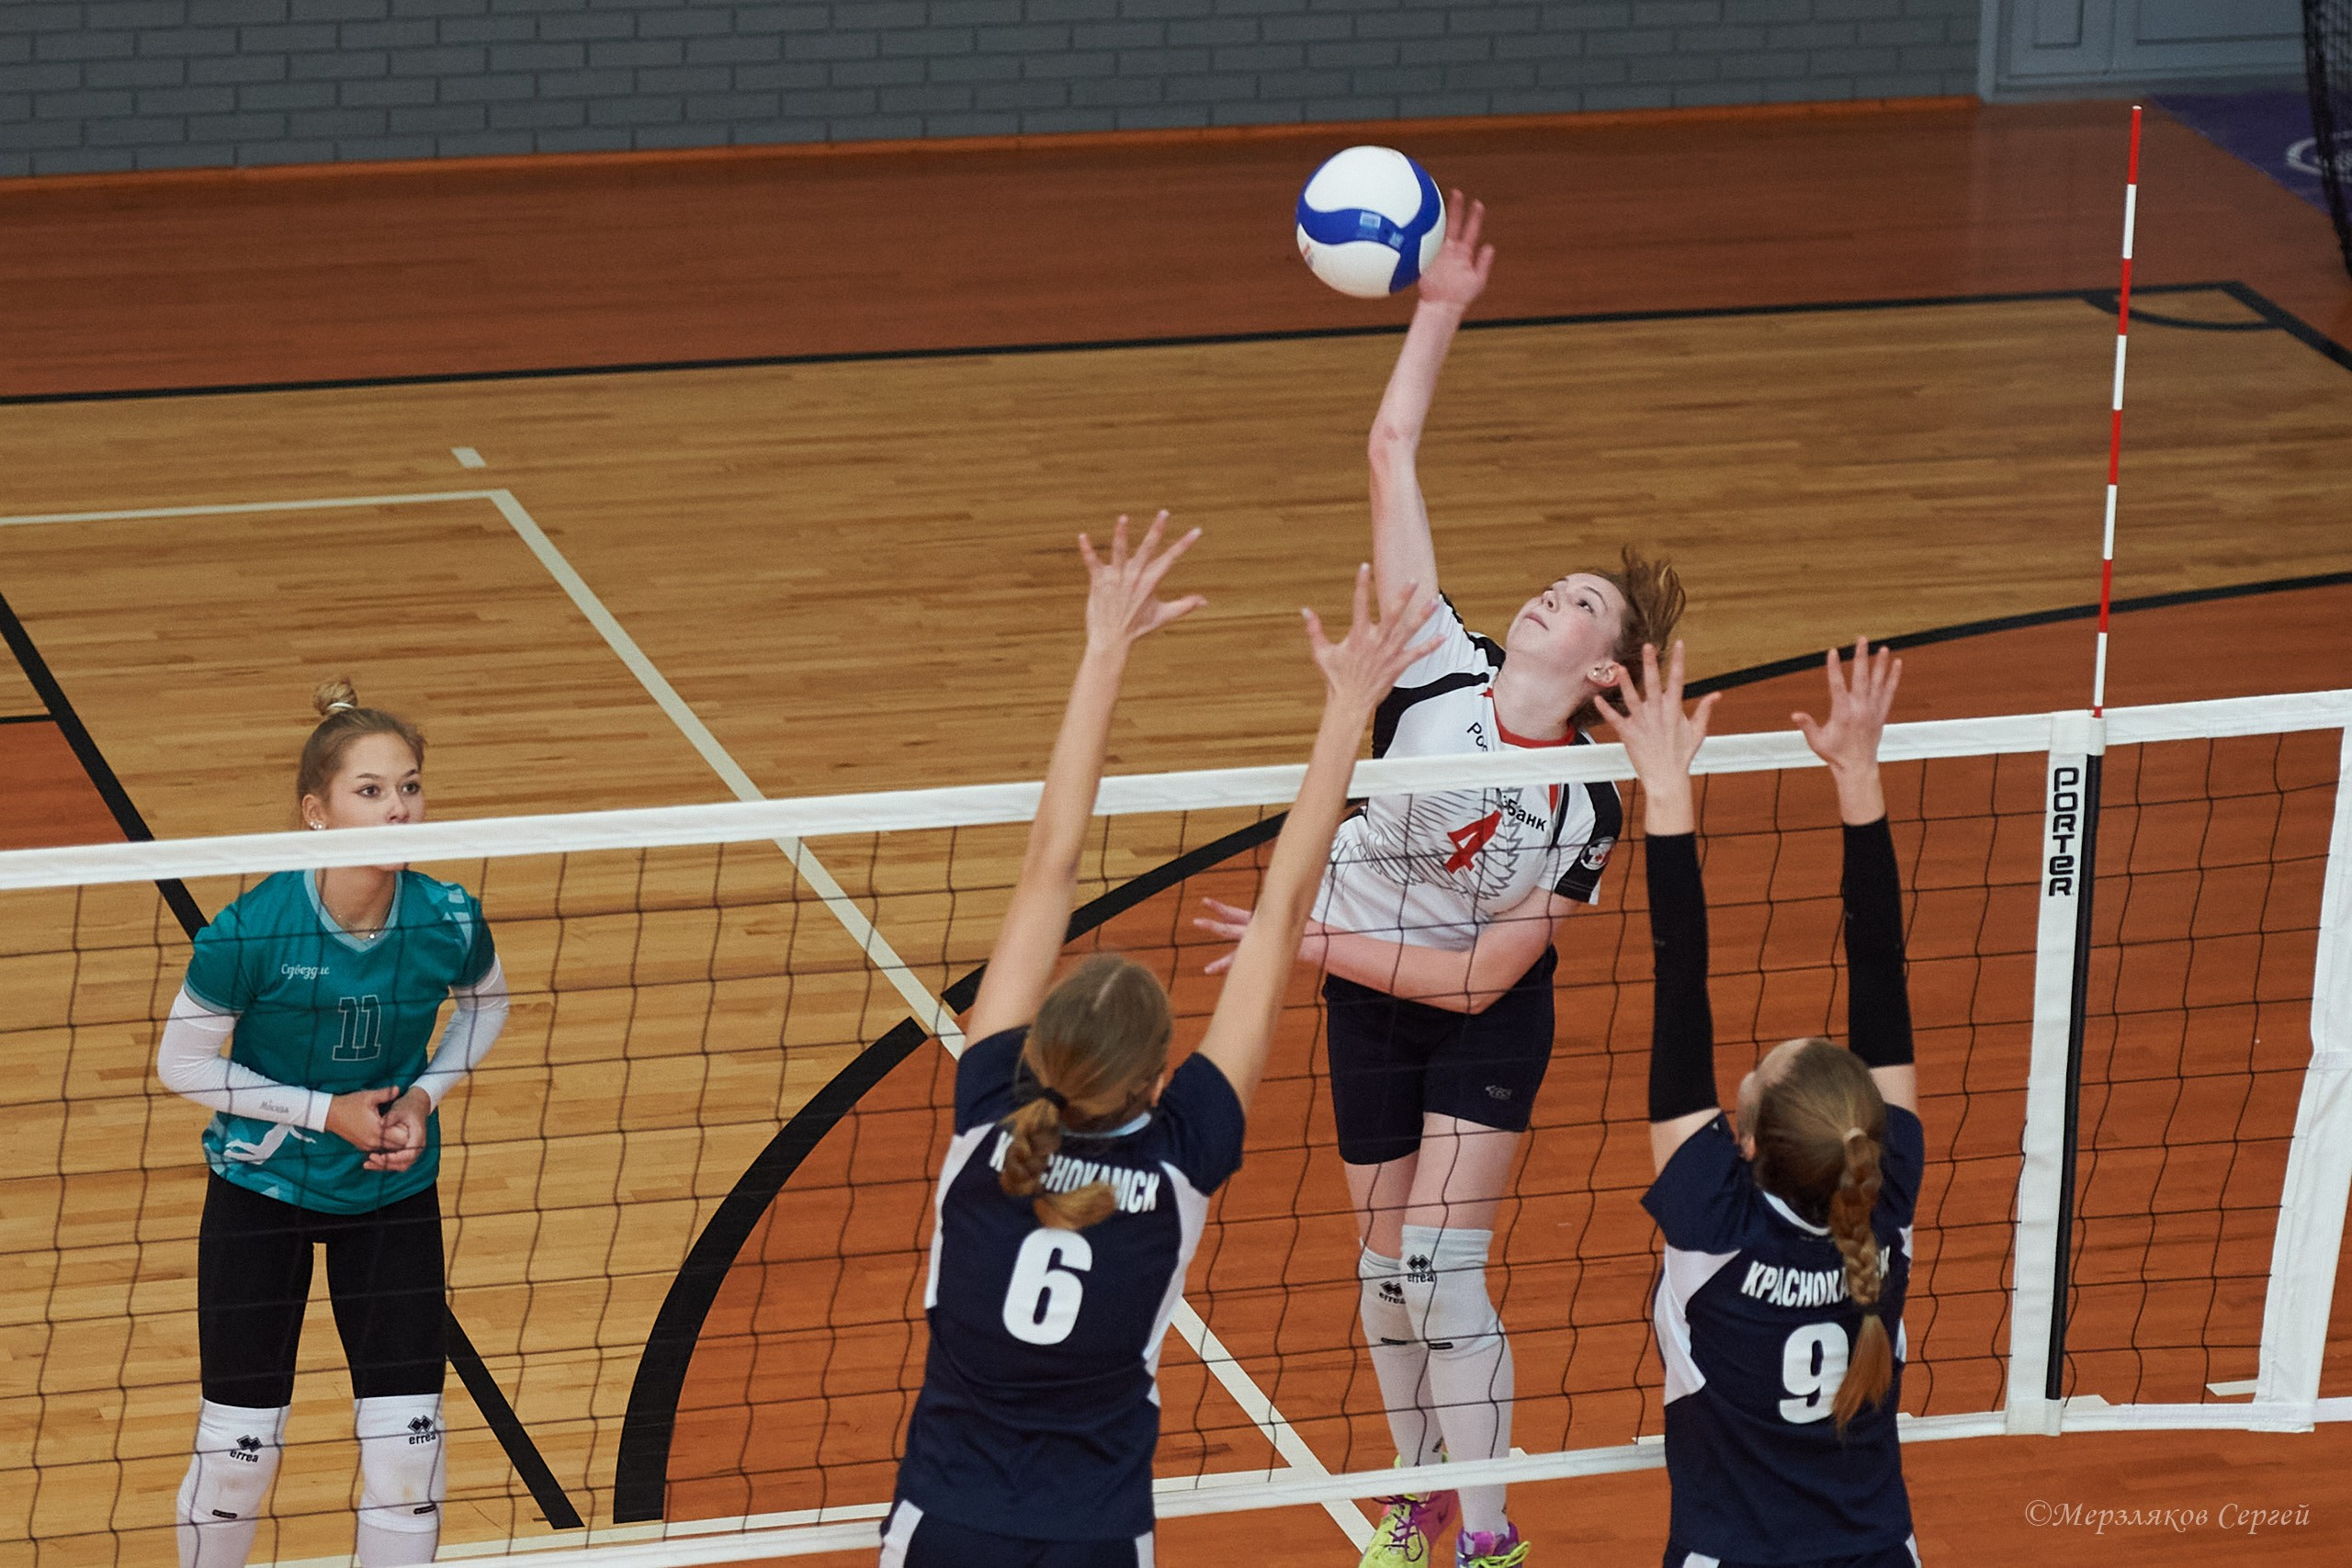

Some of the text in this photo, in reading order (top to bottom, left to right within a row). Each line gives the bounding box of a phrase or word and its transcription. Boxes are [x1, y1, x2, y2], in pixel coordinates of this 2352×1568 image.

[1444, 809, 1503, 874] 4
[332, 994, 381, 1061] 11
[1002, 1227, 1093, 1346] 6
[1740, 1245, 1891, 1308] КРАСНОКАК
[1779, 1322, 1849, 1424] 9
